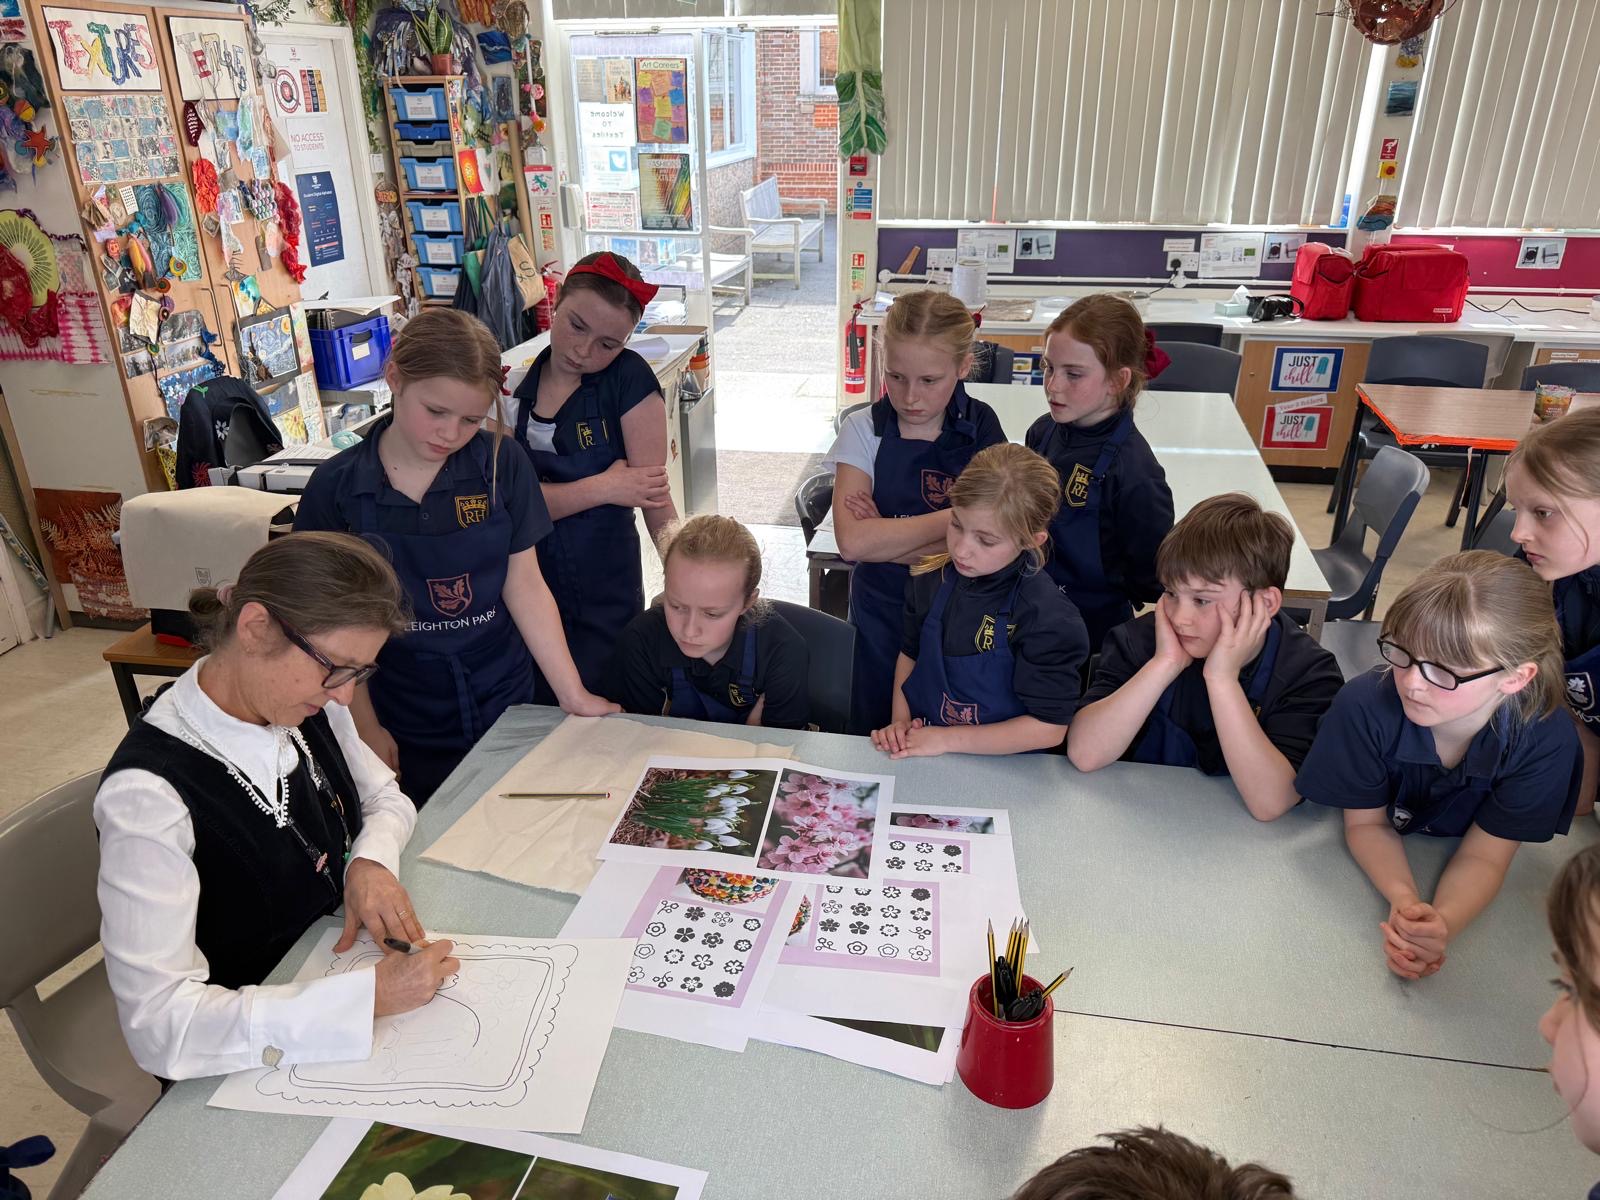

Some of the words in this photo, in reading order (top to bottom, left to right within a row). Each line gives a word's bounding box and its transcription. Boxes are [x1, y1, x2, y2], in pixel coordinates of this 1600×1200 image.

[48, 19, 158, 86] TEXTURES
[653, 61, 680, 69] Careers
[290, 134, 300, 143] NO
[302, 132, 325, 142] ACCESS
[301, 143, 325, 151] STUDENTS
[1288, 356, 1319, 367] JUST
[1284, 363, 1315, 385] chill
[1280, 415, 1306, 425] JUST
[1276, 423, 1303, 440] chill
[464, 509, 485, 524] RH
